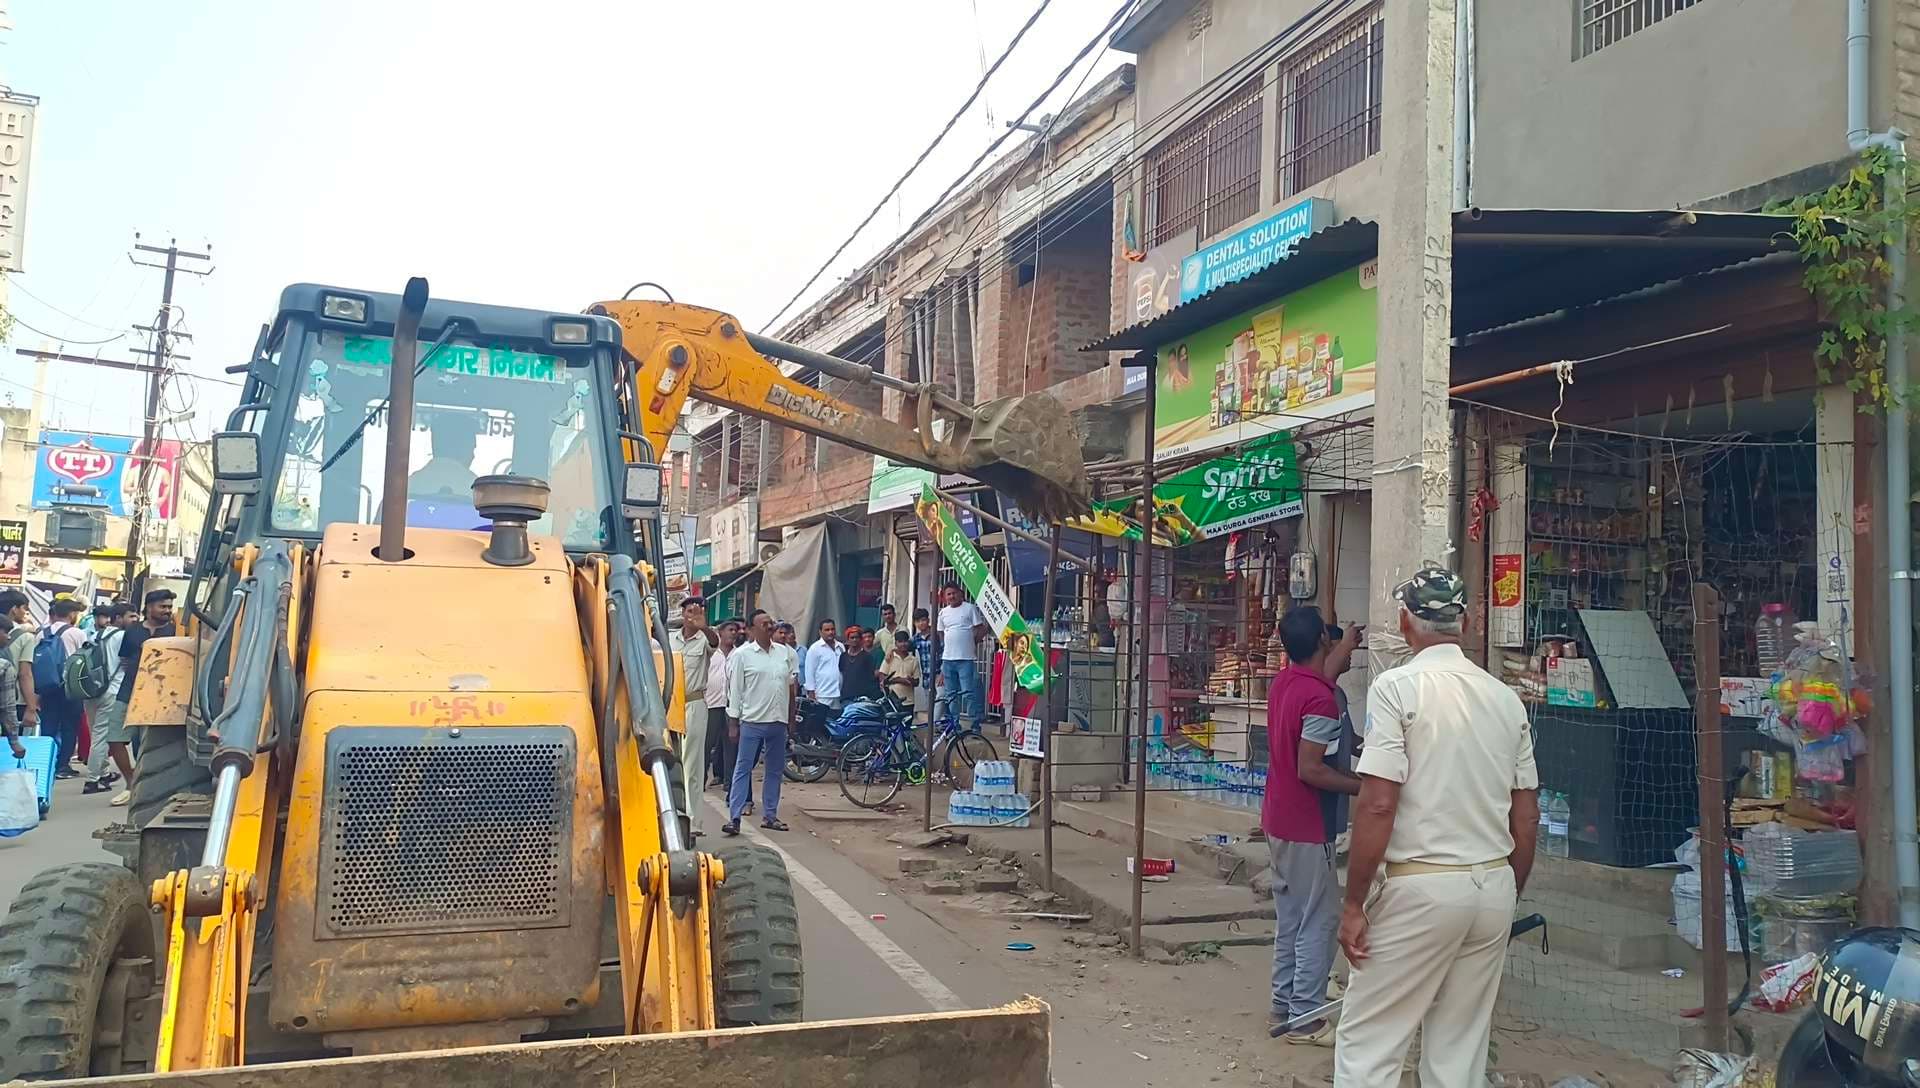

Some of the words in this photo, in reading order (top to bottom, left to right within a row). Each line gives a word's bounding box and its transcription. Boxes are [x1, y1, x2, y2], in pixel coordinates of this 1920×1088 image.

[1206, 237, 1247, 270] DENTAL
[1249, 207, 1308, 250] SOLUTION
[1211, 243, 1274, 289] MULTISPECIALITY
[1249, 490, 1271, 504] रख
[1206, 526, 1222, 536] MAA
[1223, 520, 1247, 531] DURGA
[1247, 512, 1278, 524] GENERAL
[1279, 504, 1301, 516] STORE
[949, 532, 978, 574] Sprite
[983, 602, 998, 624] STORE
[984, 591, 1004, 621] GENERAL
[985, 578, 996, 596] MAA
[995, 592, 1011, 618] DURGA
